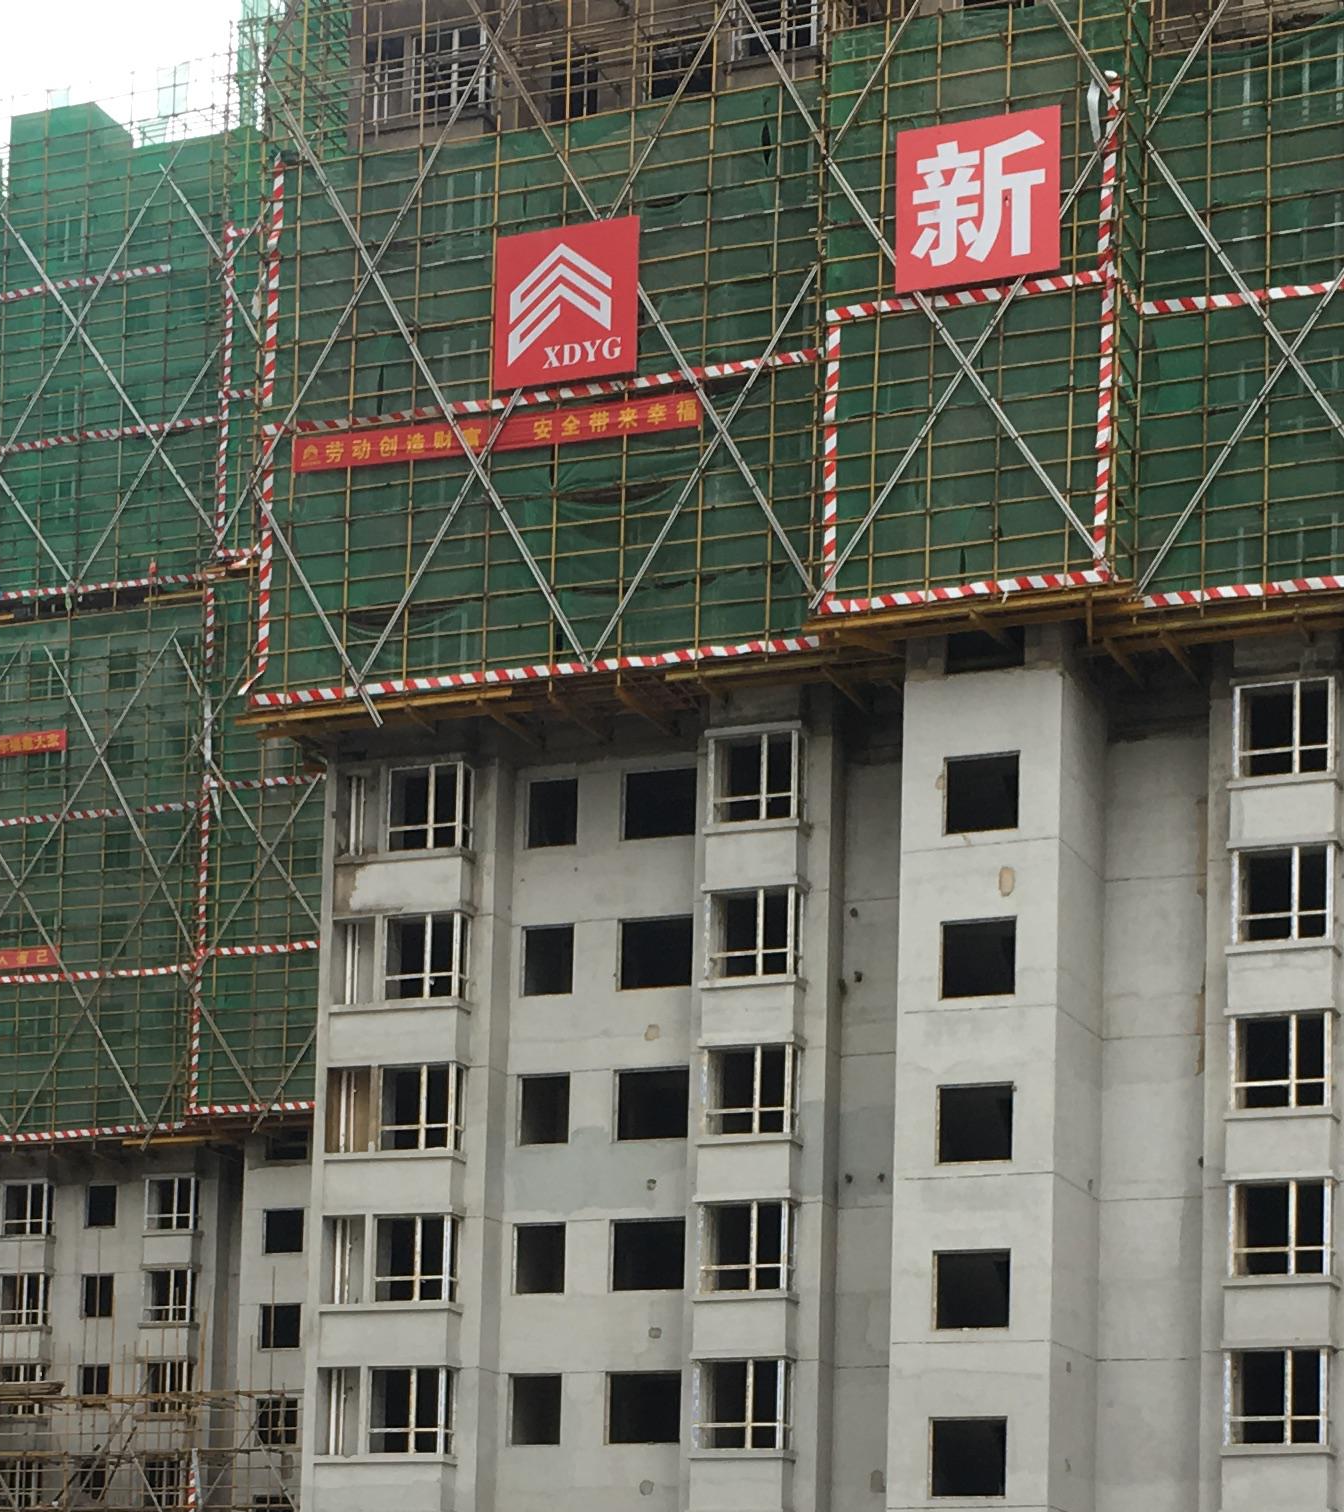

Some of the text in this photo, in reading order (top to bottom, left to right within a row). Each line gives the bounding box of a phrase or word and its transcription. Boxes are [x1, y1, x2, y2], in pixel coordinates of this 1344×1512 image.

[910, 129, 1046, 267] 新
[542, 336, 622, 370] XDYG
[533, 400, 699, 440] 安全带来幸福
